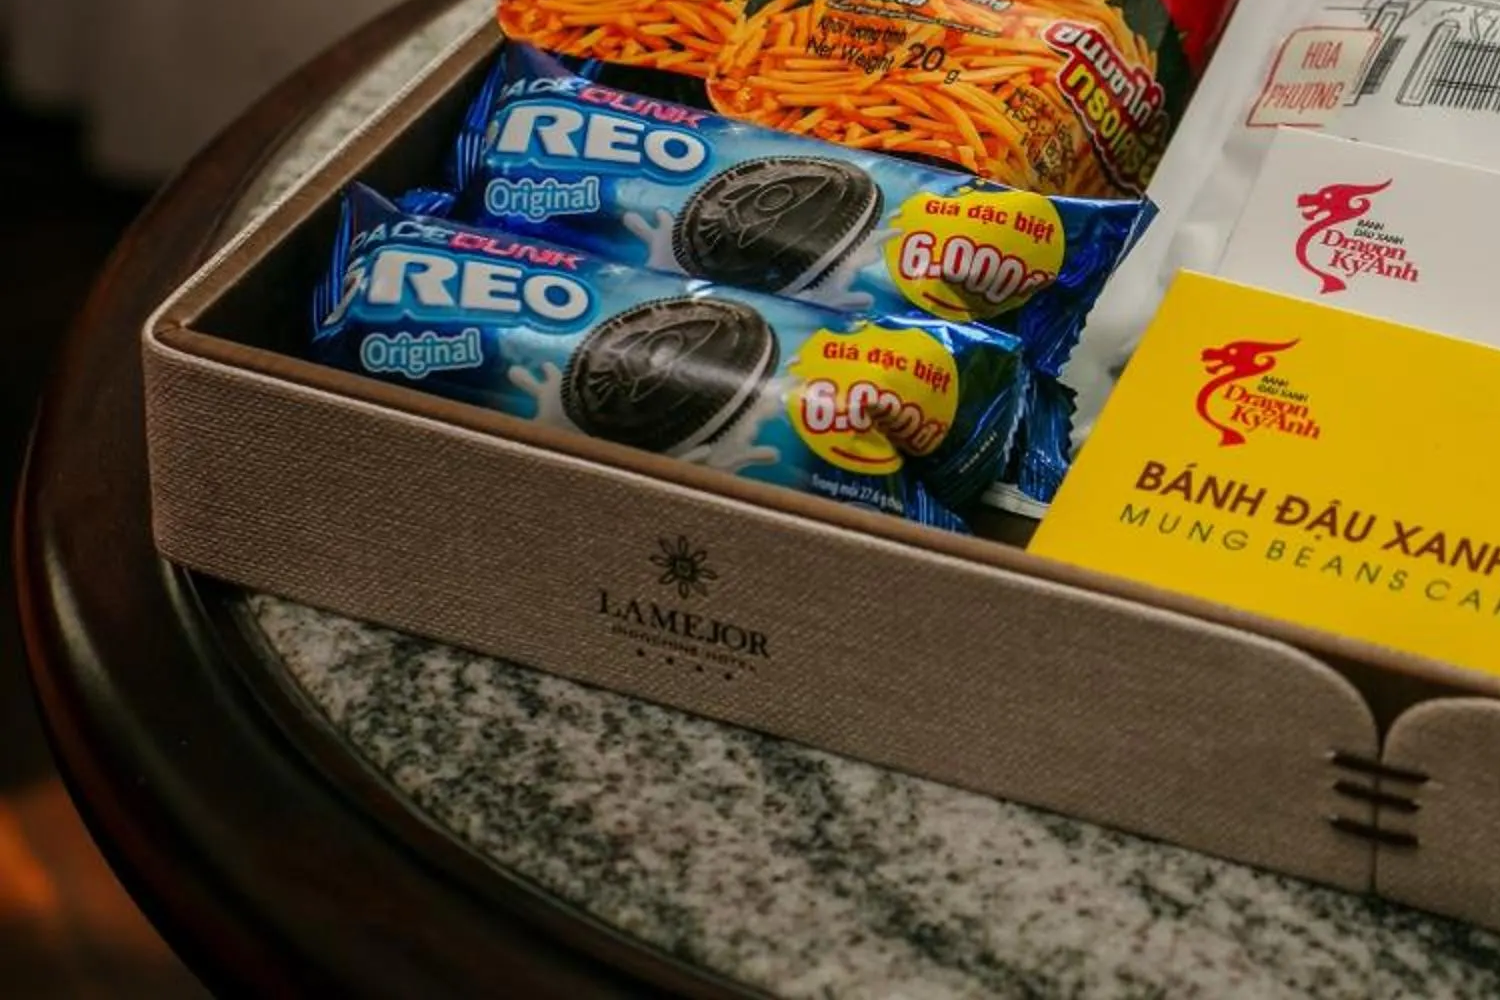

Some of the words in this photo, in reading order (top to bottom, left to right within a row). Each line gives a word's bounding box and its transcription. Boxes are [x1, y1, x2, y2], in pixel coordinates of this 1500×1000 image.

[901, 43, 946, 72] 20
[488, 105, 705, 171] REO
[488, 180, 598, 220] Original
[968, 204, 1008, 225] đặc
[1014, 211, 1056, 244] biệt
[1320, 229, 1407, 261] Dragon
[362, 331, 481, 374] Original
[823, 341, 859, 360] Giá
[867, 347, 908, 371] đặc
[914, 358, 951, 394] biệt
[1223, 384, 1309, 418] Dragon
[1135, 460, 1267, 517] BÁNH
[1274, 495, 1377, 543] ĐẬU
[1119, 503, 1249, 551] MUNG
[1266, 539, 1408, 592] BEANS
[599, 587, 771, 659] LAMEJOR
